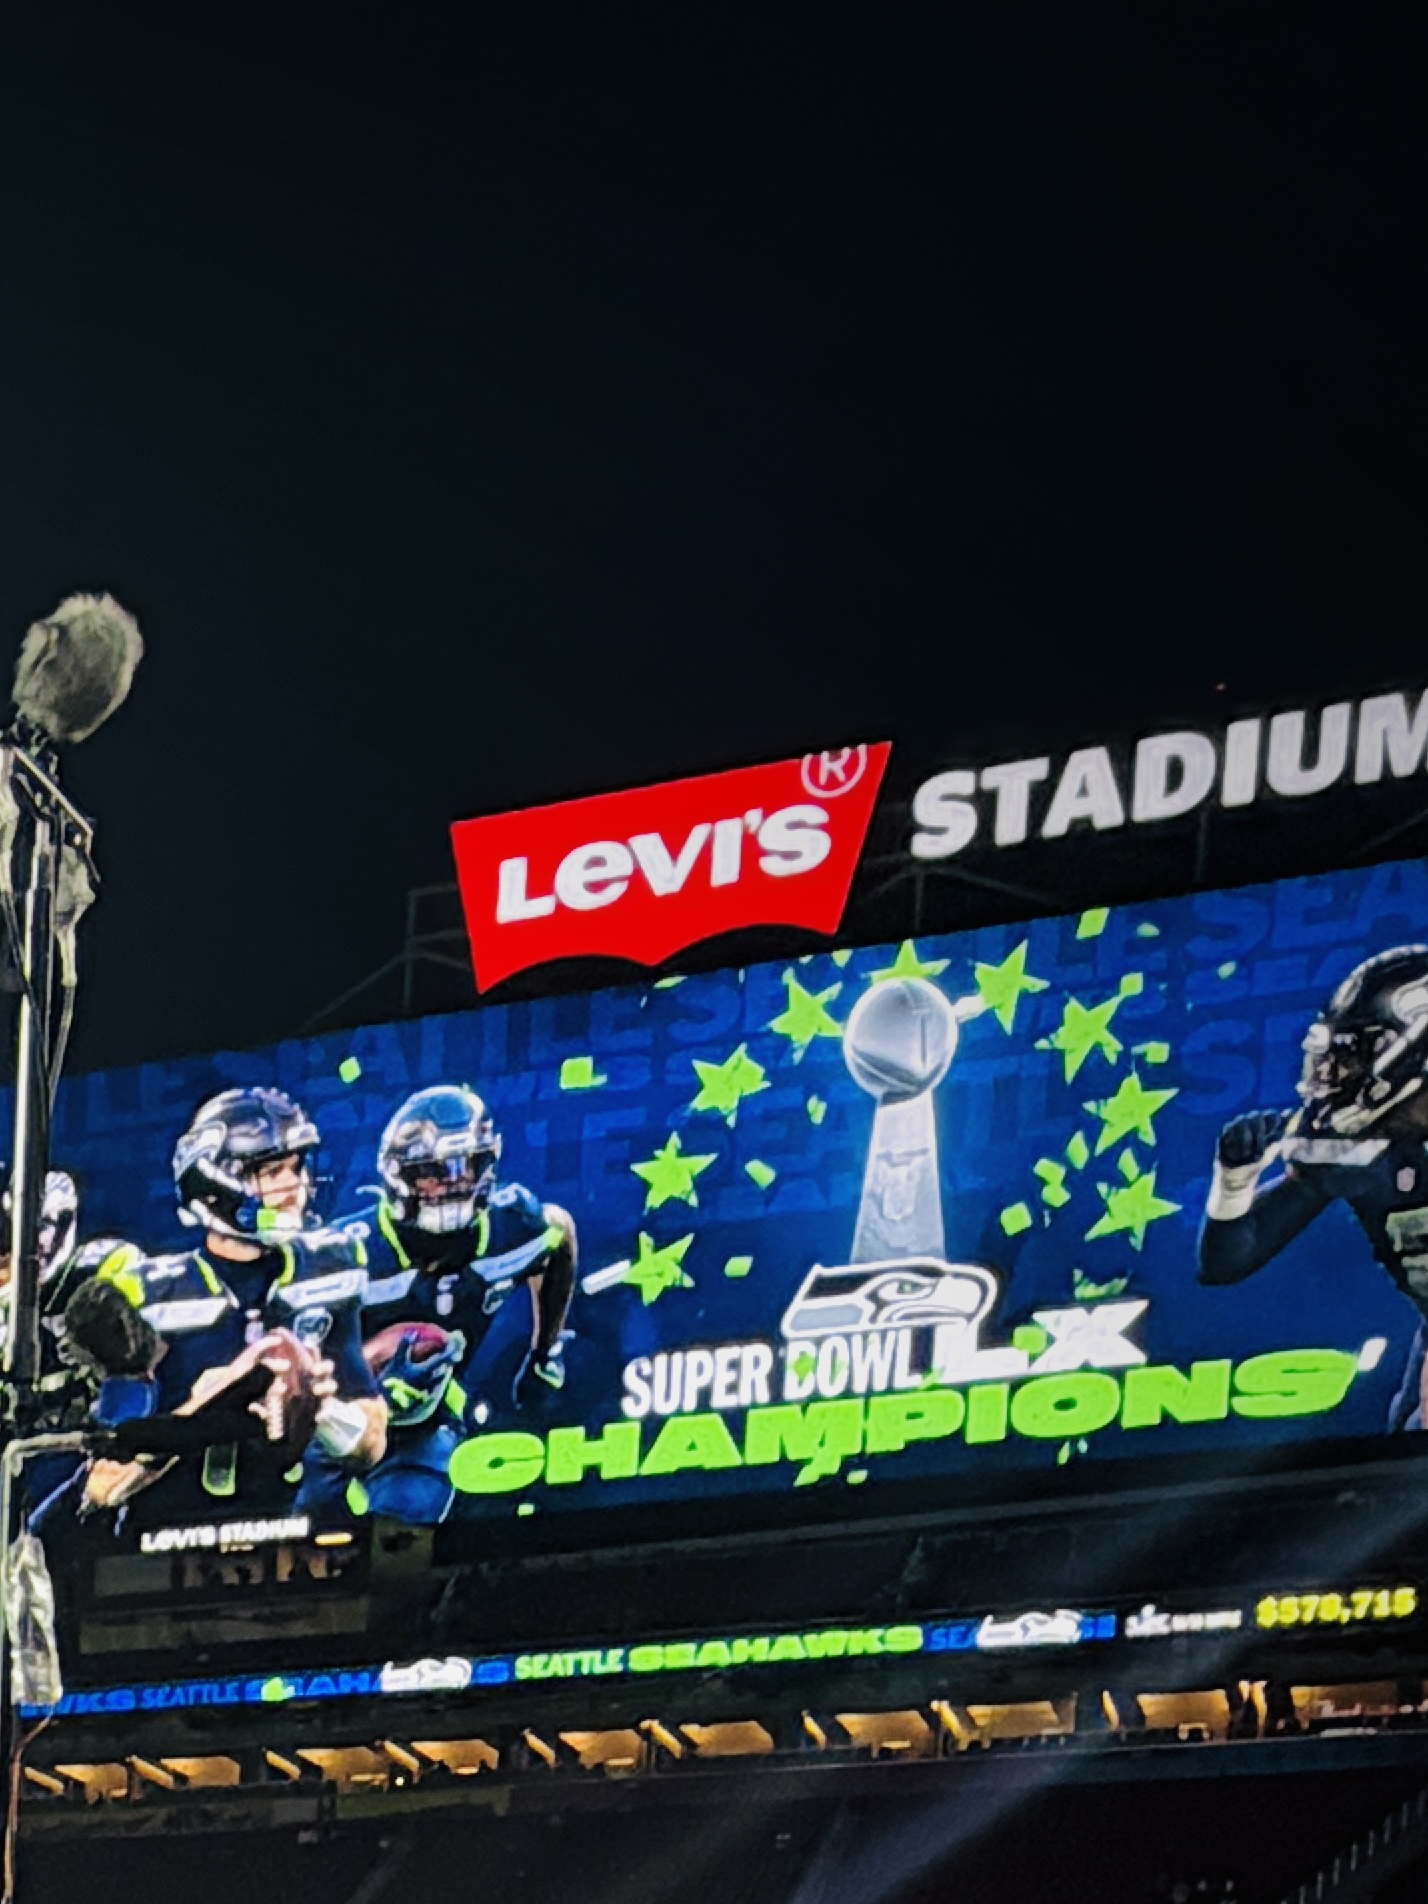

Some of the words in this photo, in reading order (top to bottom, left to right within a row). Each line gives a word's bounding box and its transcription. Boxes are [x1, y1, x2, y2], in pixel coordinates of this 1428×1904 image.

[910, 684, 1428, 860] STADIUM
[623, 1342, 775, 1417] SUPER
[783, 1326, 920, 1401] BOWL
[930, 1298, 1149, 1385] LX
[515, 1649, 624, 1681] SEATTLE
[628, 1625, 925, 1673] SEAHAWKS
